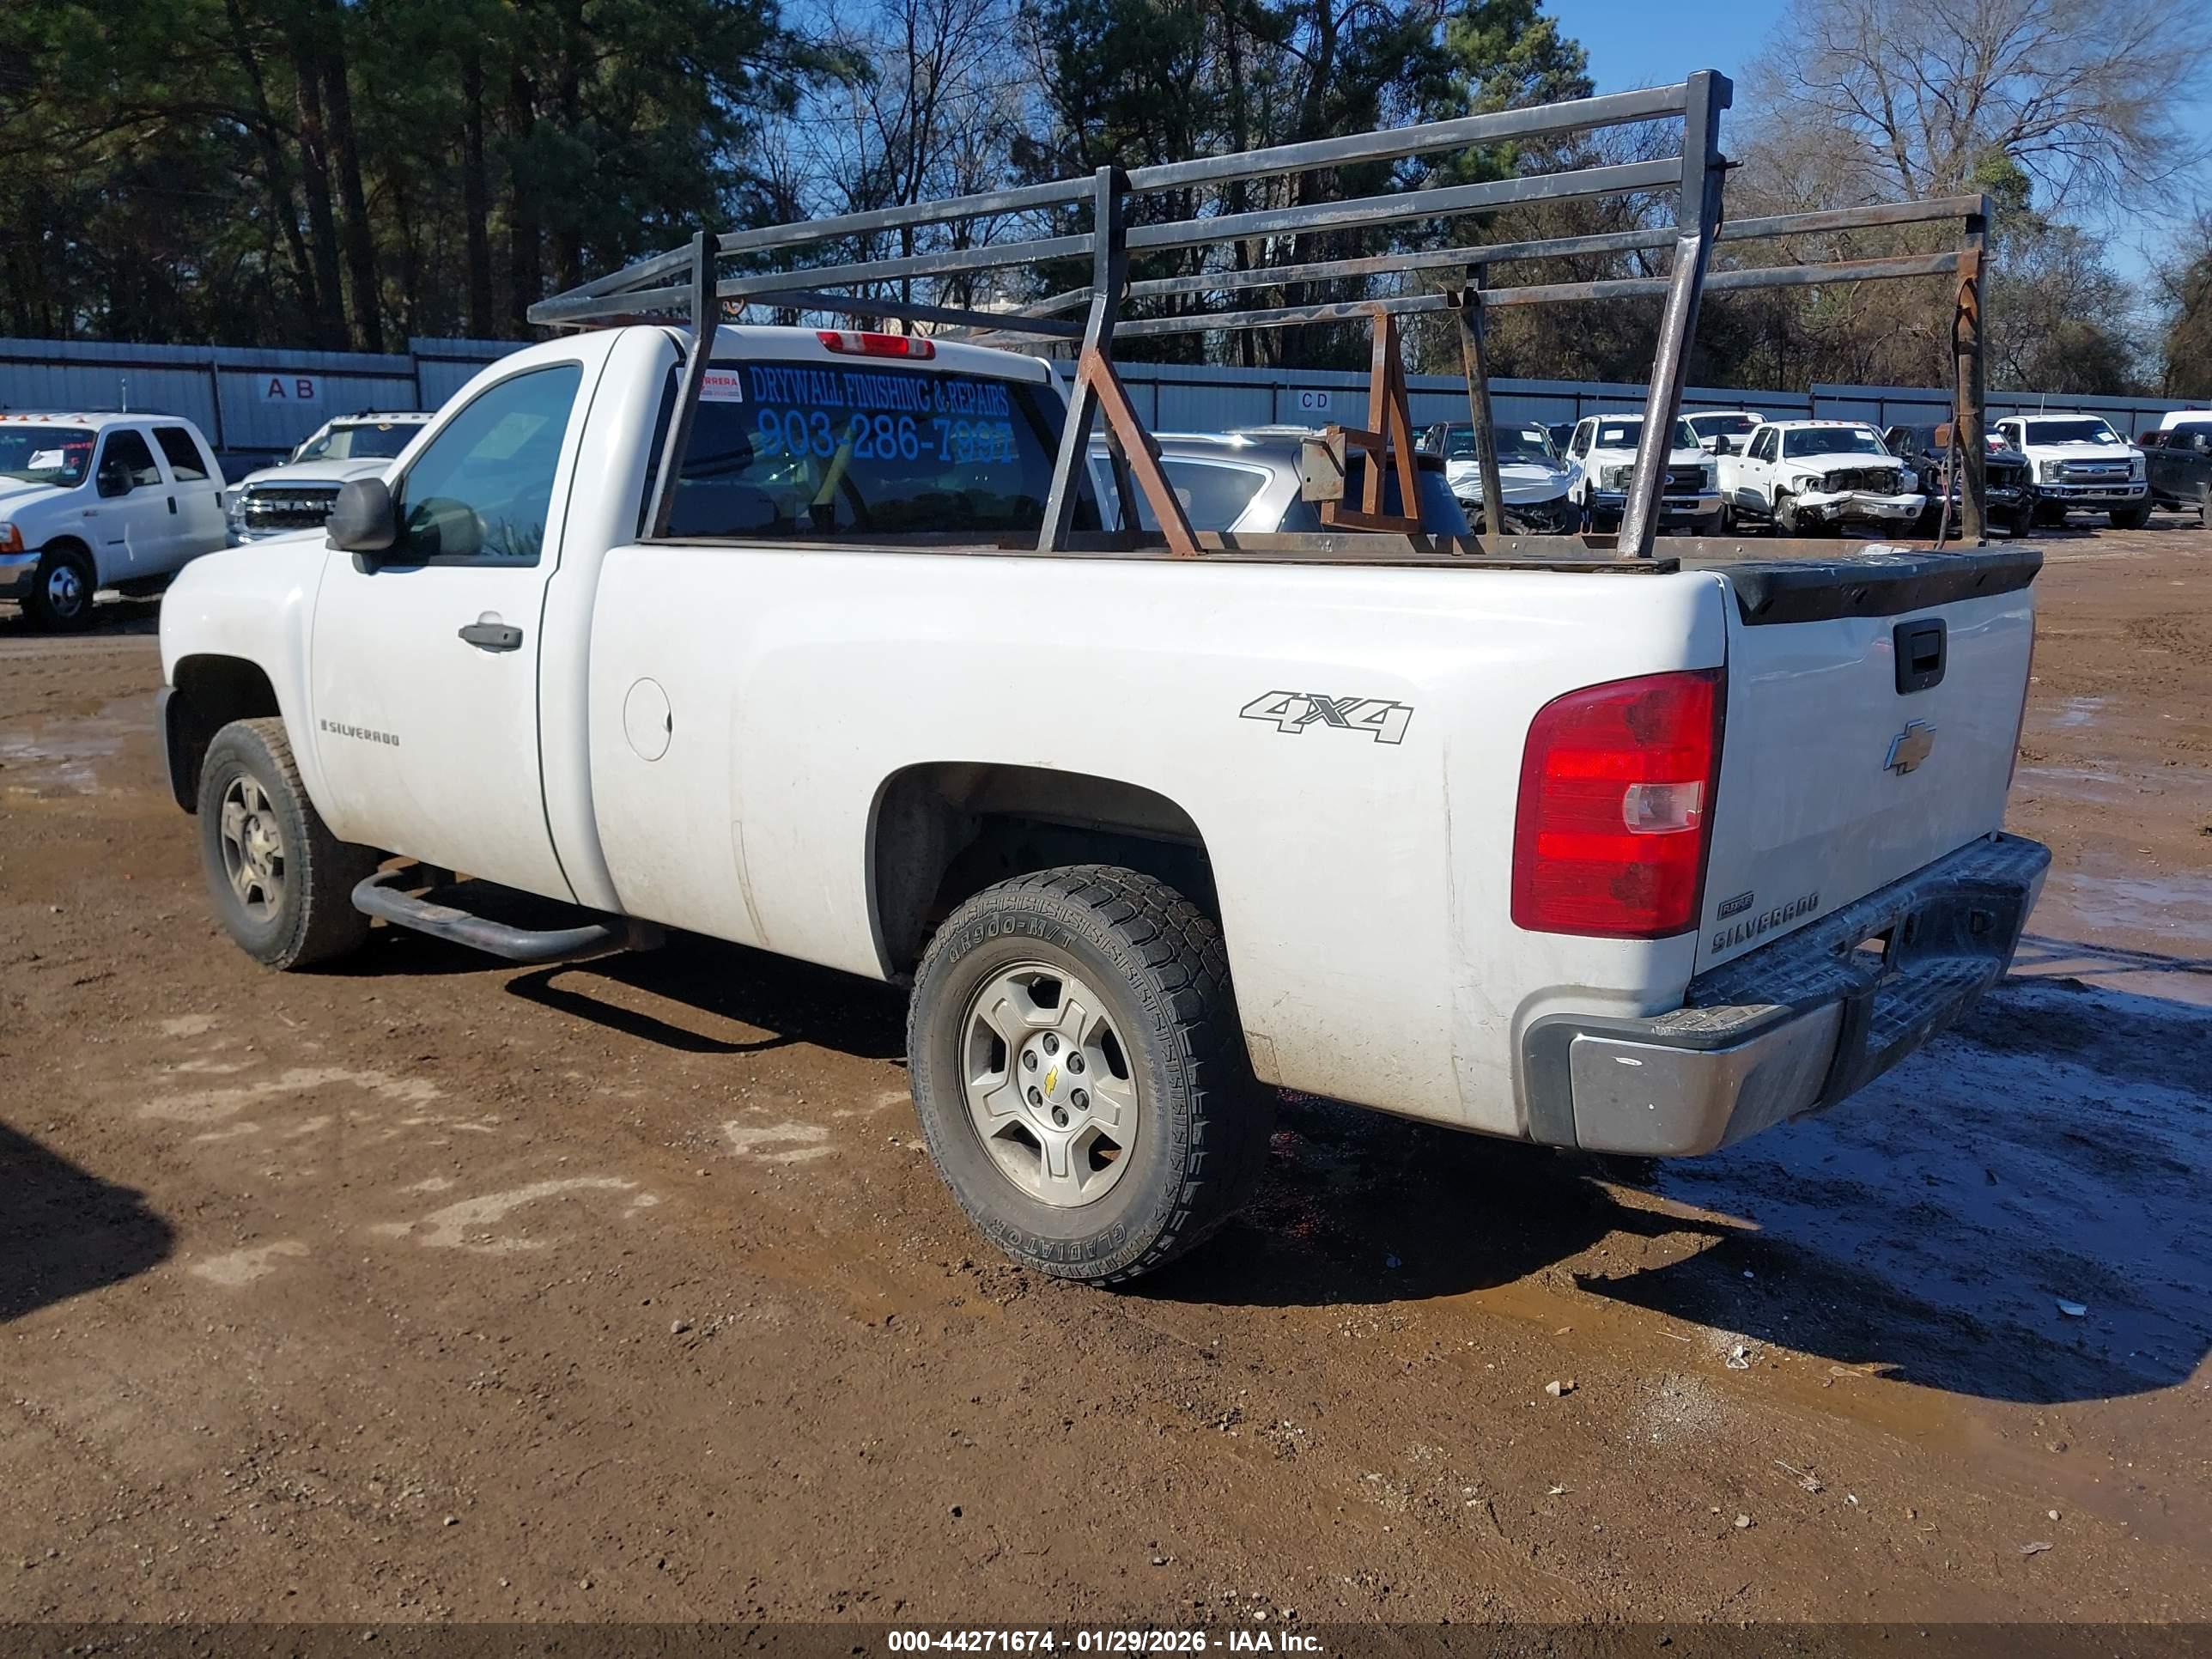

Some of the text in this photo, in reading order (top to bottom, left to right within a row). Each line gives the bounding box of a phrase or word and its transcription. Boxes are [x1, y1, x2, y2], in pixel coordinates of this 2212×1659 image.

[268, 378, 314, 399] A B
[750, 366, 1010, 417] DRYWALL FINISHING & REPAIRS
[1302, 392, 1328, 408] C D
[329, 721, 399, 746] SILVERADO
[1239, 690, 1415, 745] 4X4
[1711, 892, 1819, 954] SILVERADO
[989, 1218, 1127, 1261] GLADIATOR
